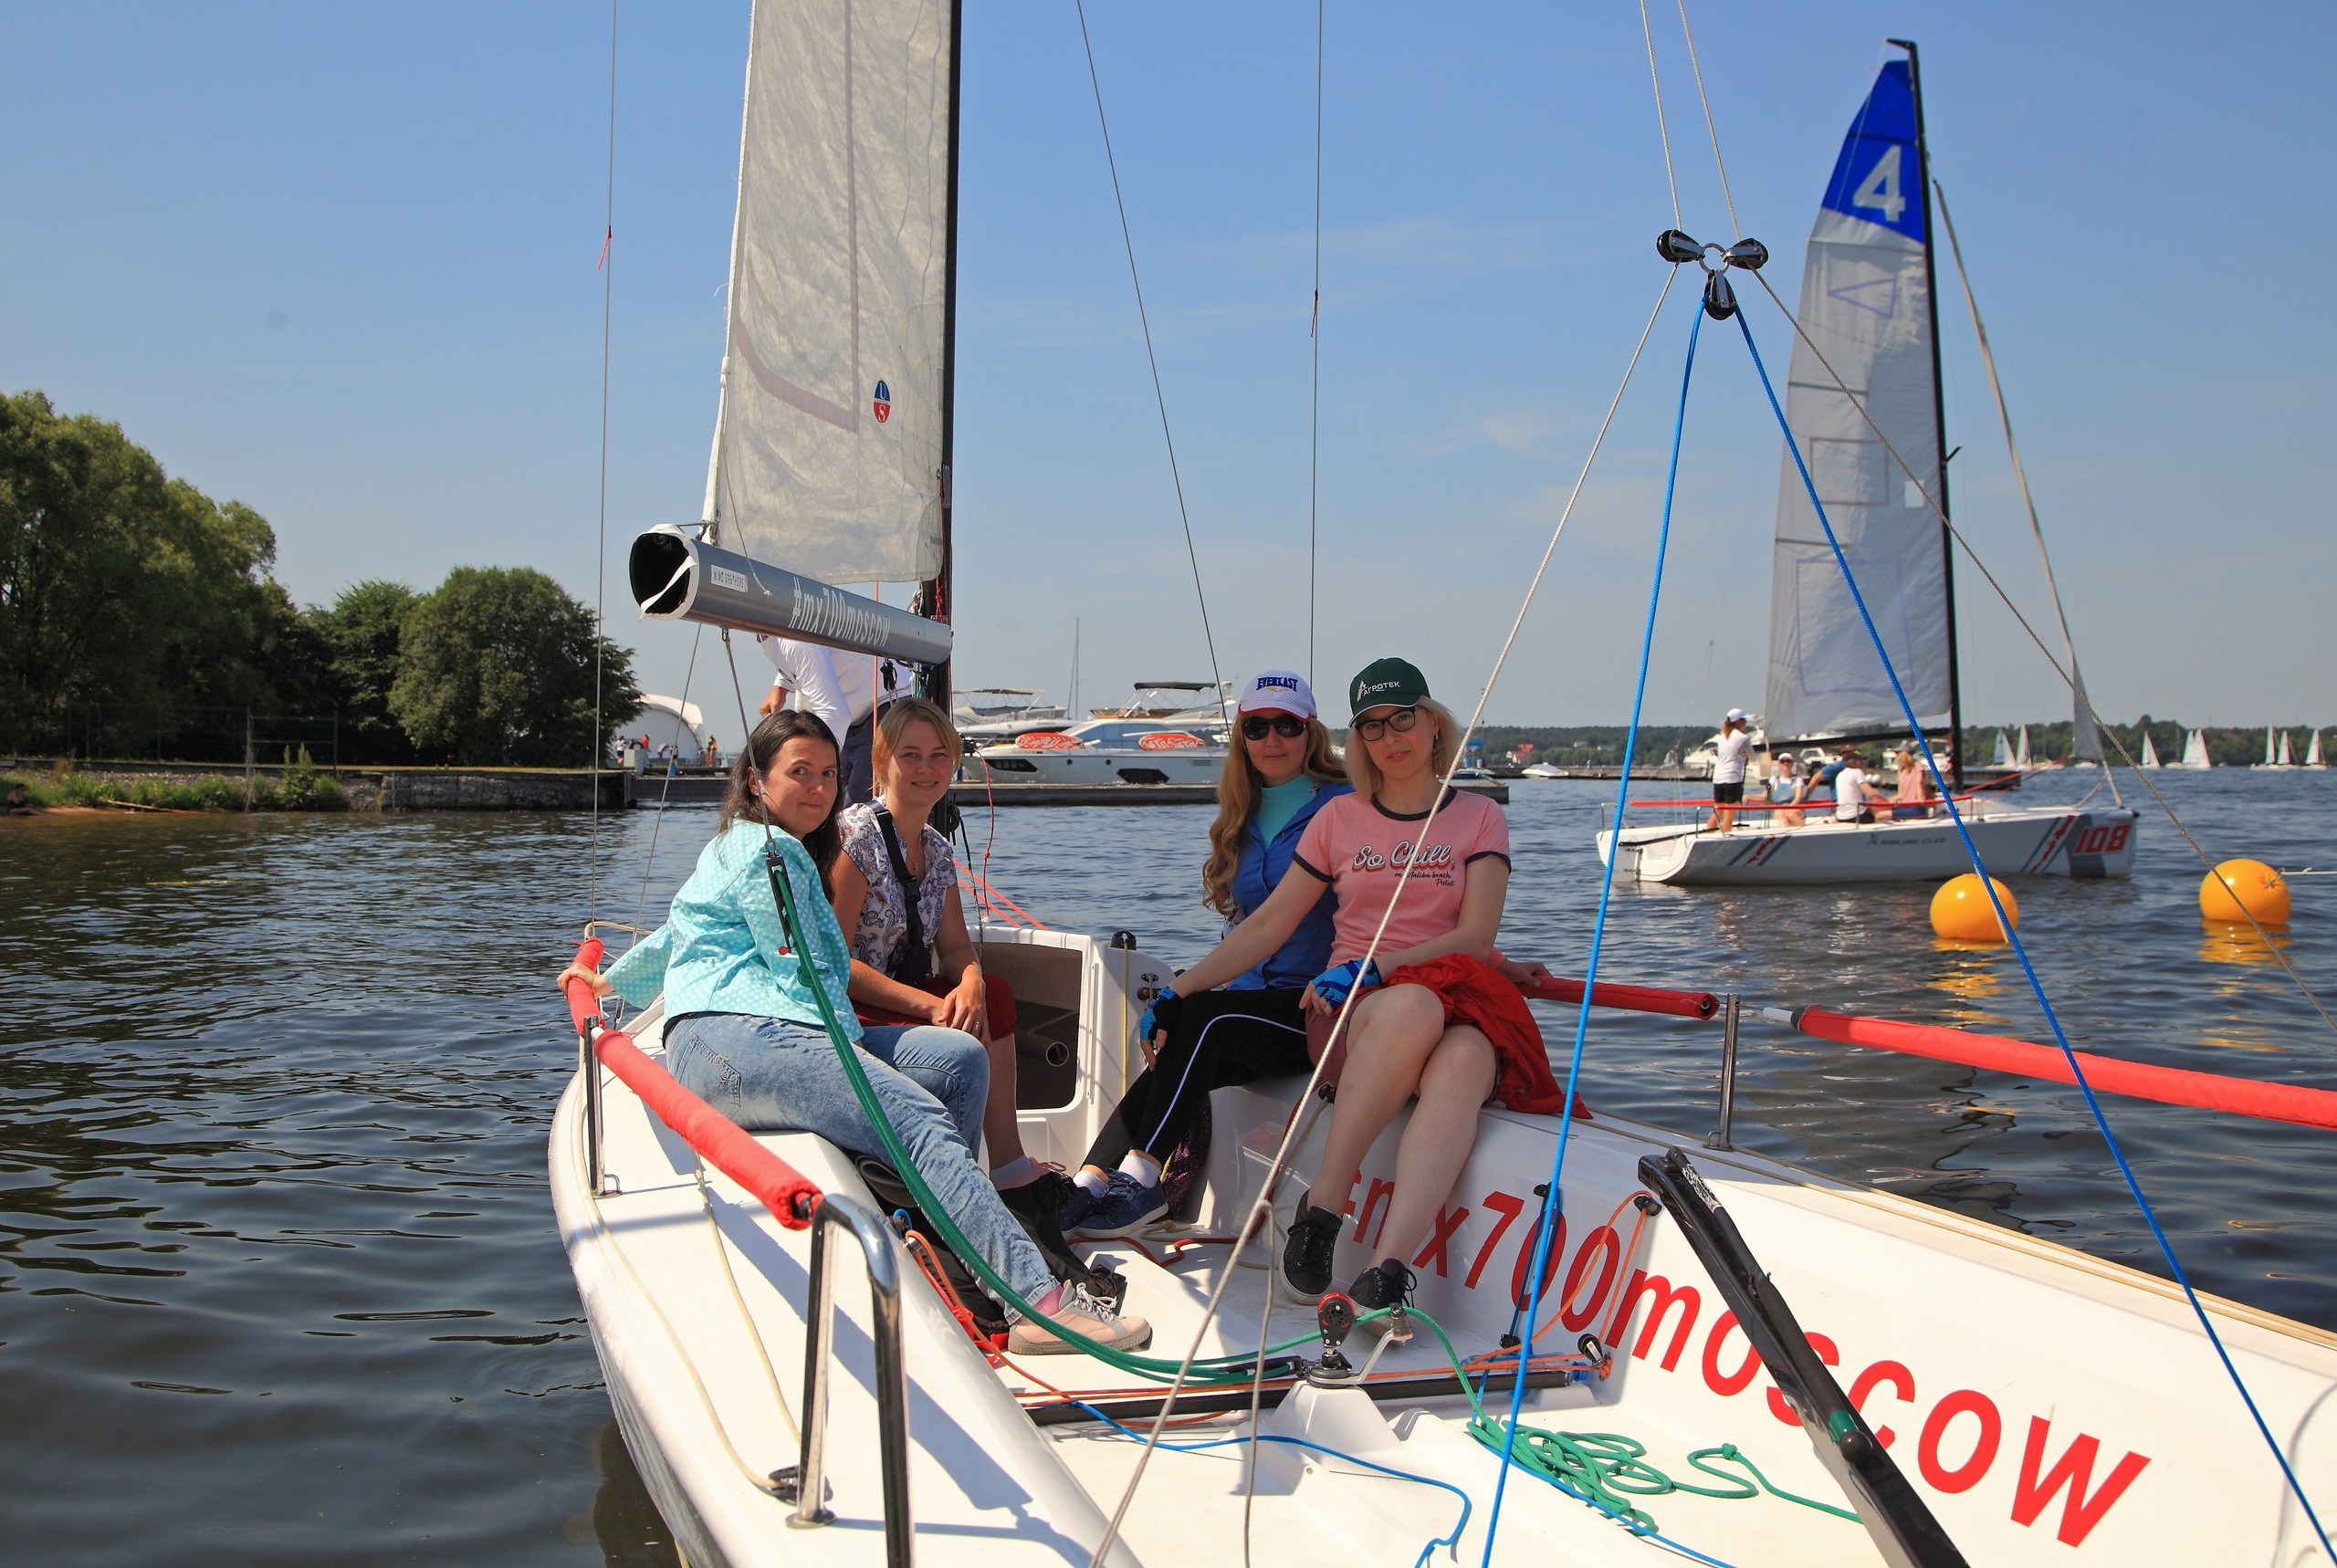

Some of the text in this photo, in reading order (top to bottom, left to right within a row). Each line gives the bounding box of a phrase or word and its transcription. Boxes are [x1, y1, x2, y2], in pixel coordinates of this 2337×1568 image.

[1852, 145, 1906, 223] 4
[788, 576, 891, 647] #mx700moscow
[1256, 676, 1298, 692] EVERLAST
[1352, 844, 1386, 873] So
[2074, 823, 2131, 855] 108
[1342, 1168, 2153, 1549] mx700mocow
